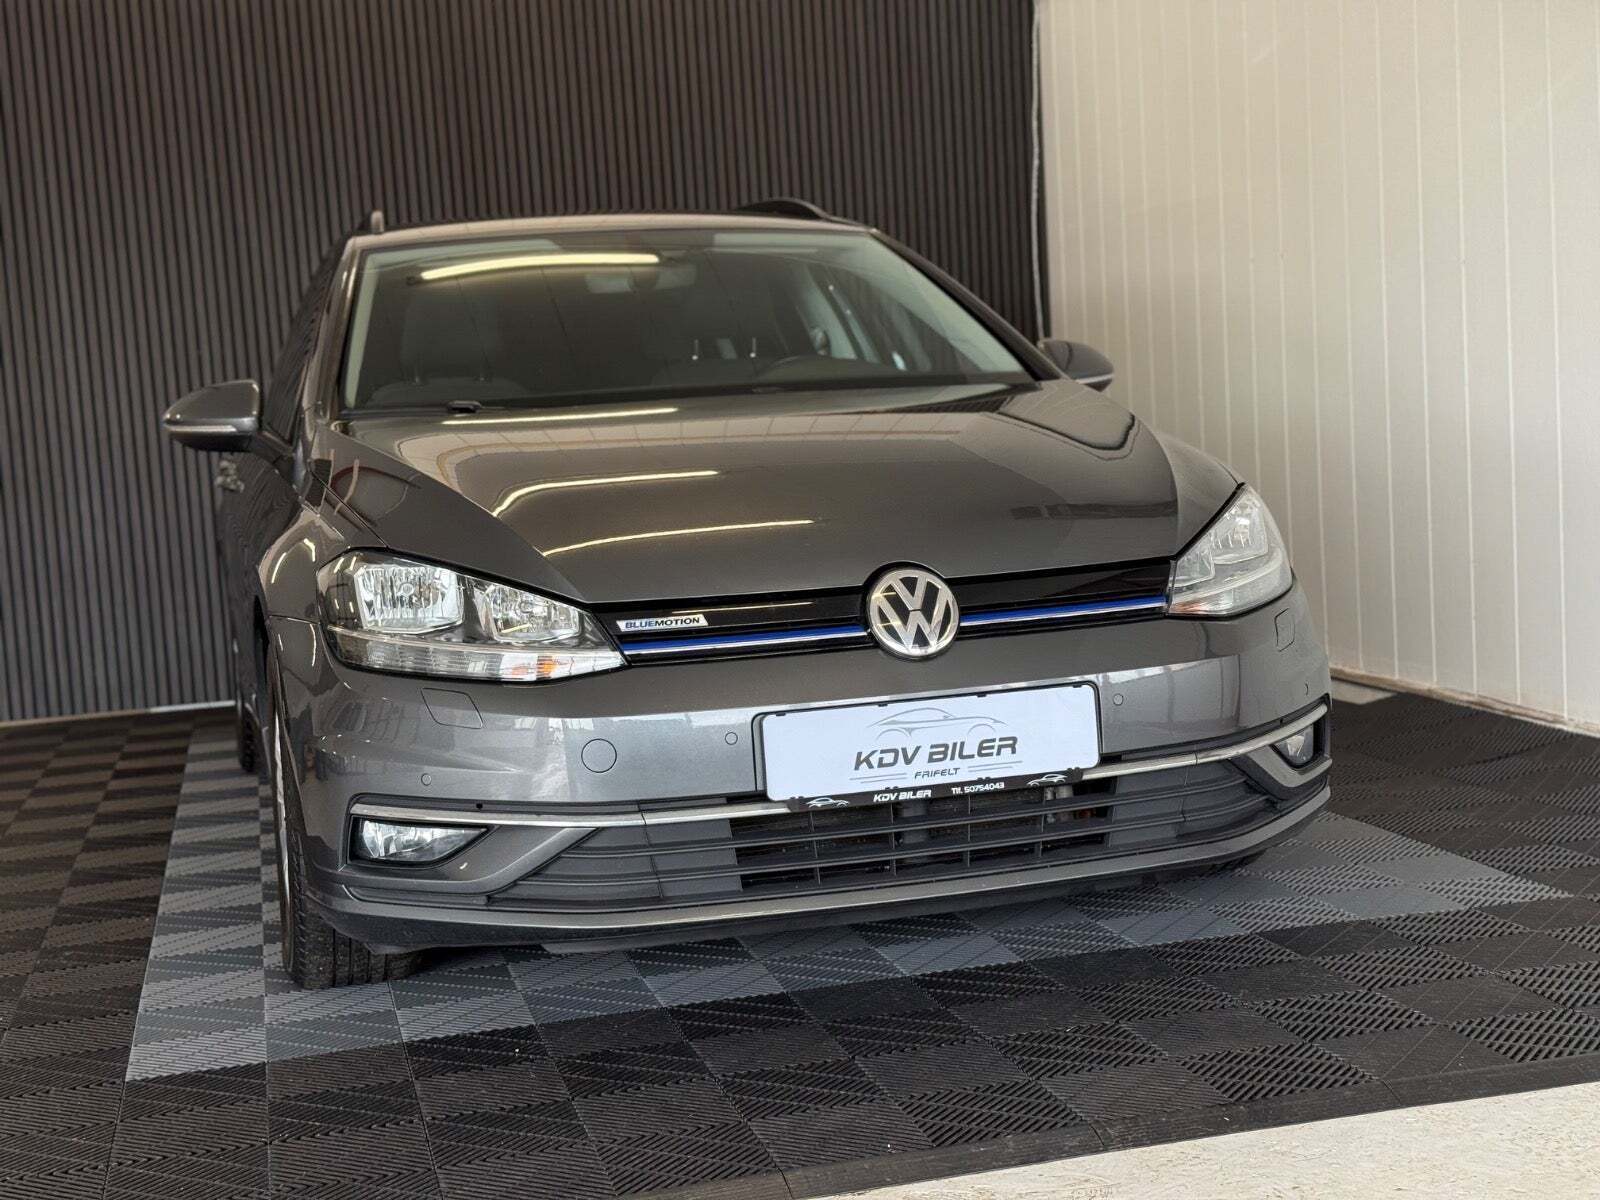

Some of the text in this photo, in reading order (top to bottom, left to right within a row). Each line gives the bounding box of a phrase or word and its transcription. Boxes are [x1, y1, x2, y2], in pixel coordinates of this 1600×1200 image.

[870, 569, 957, 656] VW
[625, 617, 700, 629] BLUEMOTION
[854, 736, 1018, 771] KDV BILER
[914, 767, 961, 780] FRIFELT
[964, 782, 1005, 793] 50754043
[873, 789, 932, 803] KDV BILER
